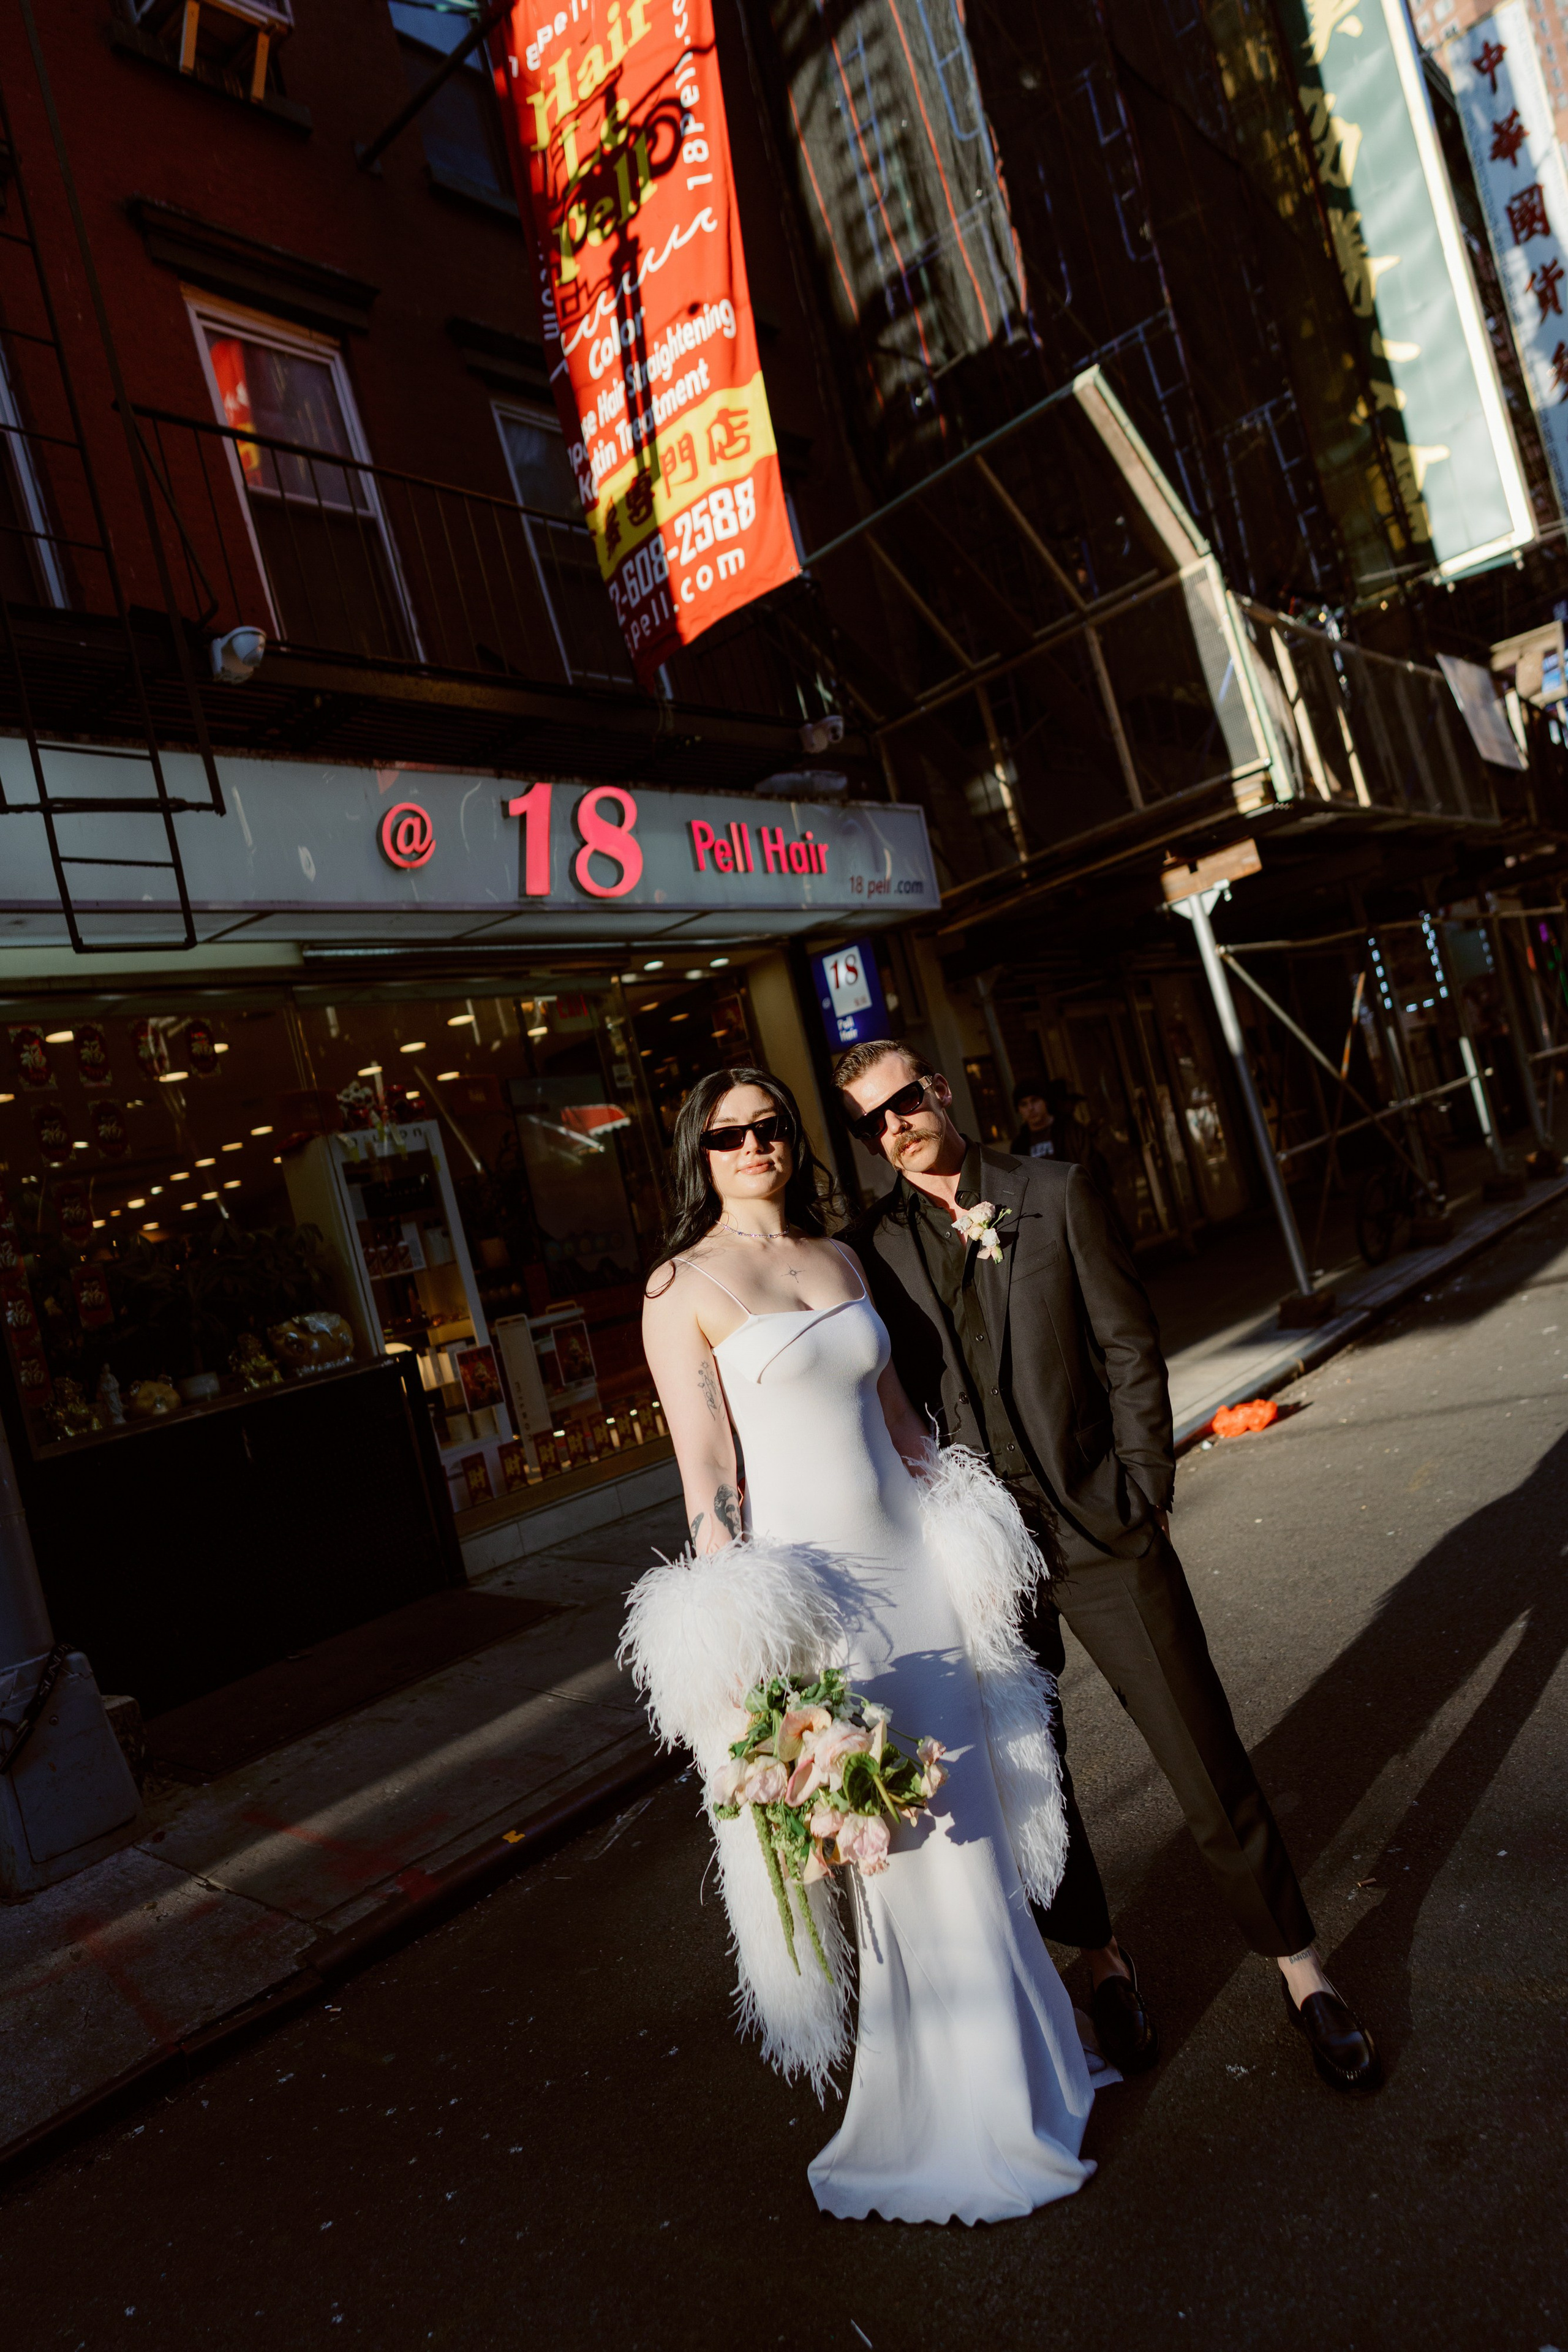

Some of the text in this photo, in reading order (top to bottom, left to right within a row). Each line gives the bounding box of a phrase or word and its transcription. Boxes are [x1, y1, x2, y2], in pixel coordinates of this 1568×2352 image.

[527, 0, 652, 151] Hair
[589, 306, 646, 380] Color
[597, 298, 736, 428] Hair Straightening
[615, 358, 710, 455] Treatment
[509, 782, 643, 897] 18
[690, 818, 754, 873] Pell
[760, 826, 829, 875] Hair
[850, 875, 924, 899] 18 pell .com
[830, 954, 859, 989] 18
[1289, 1950, 1311, 1964] BANDIT
